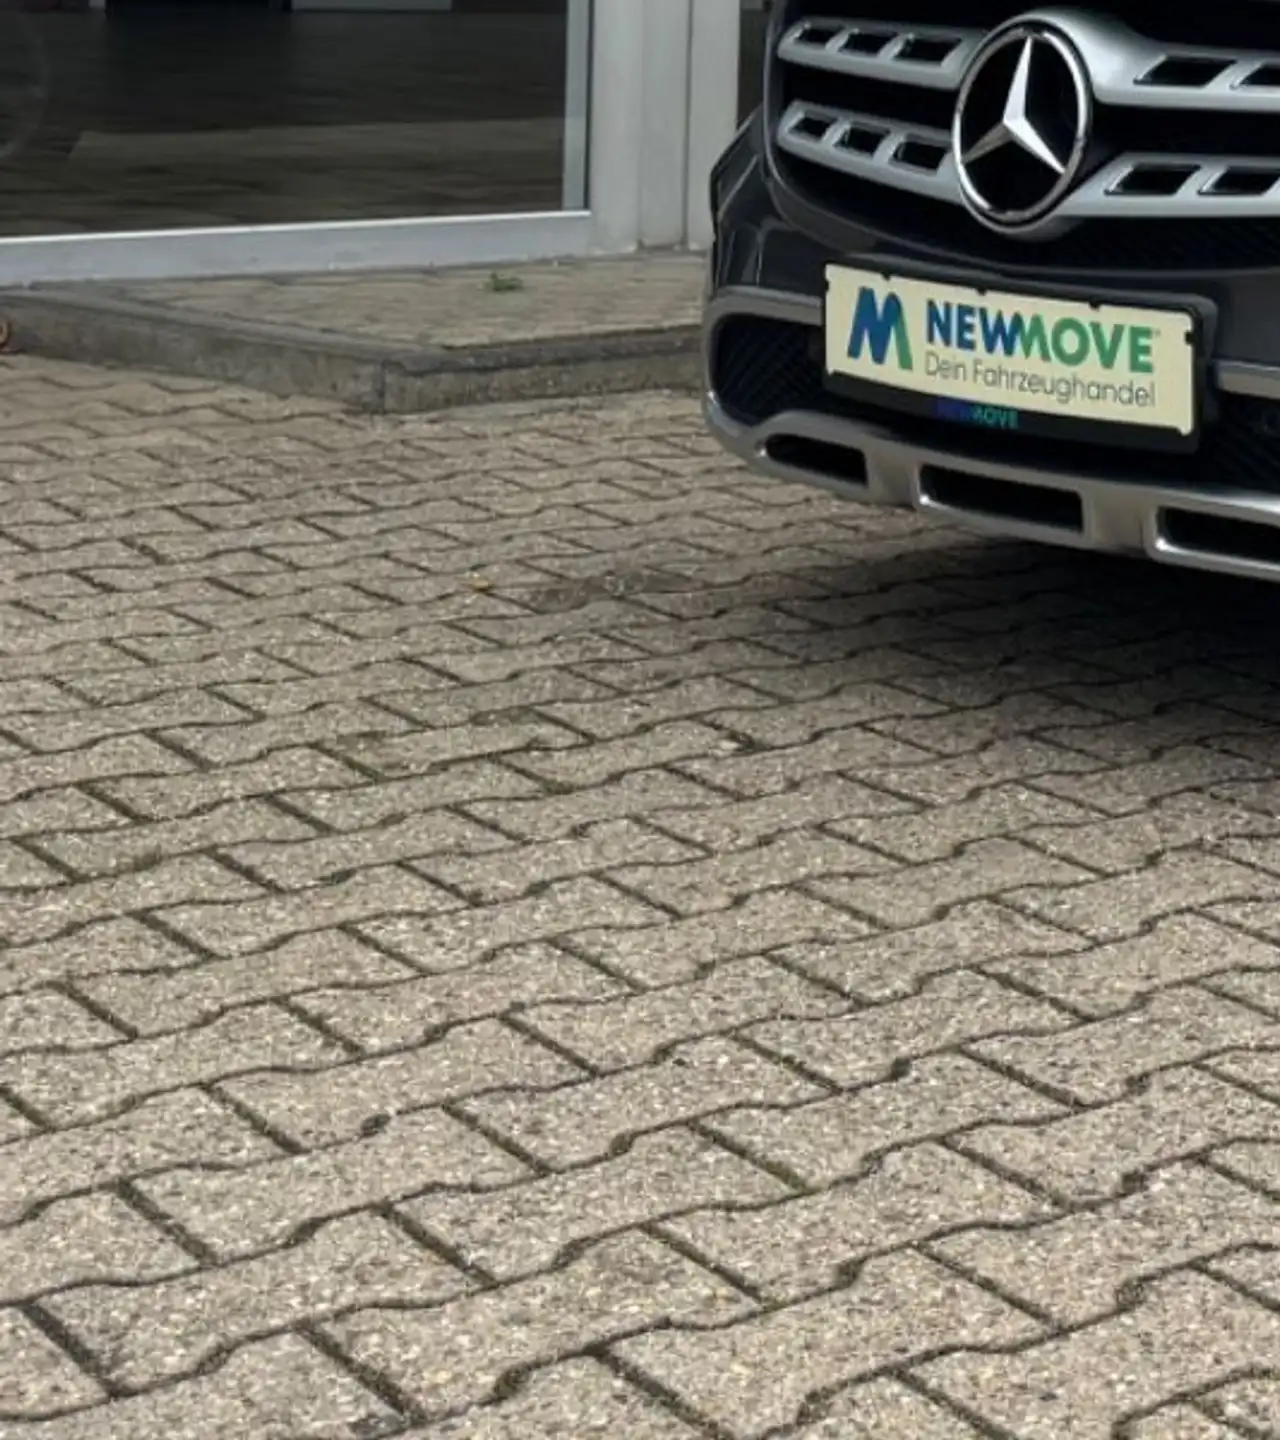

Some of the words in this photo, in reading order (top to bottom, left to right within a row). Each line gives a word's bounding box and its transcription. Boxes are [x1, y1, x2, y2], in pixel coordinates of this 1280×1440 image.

[926, 299, 1156, 373] NEWMOVE
[924, 351, 968, 382] Dein
[973, 358, 1156, 407] Fahrzeughandel
